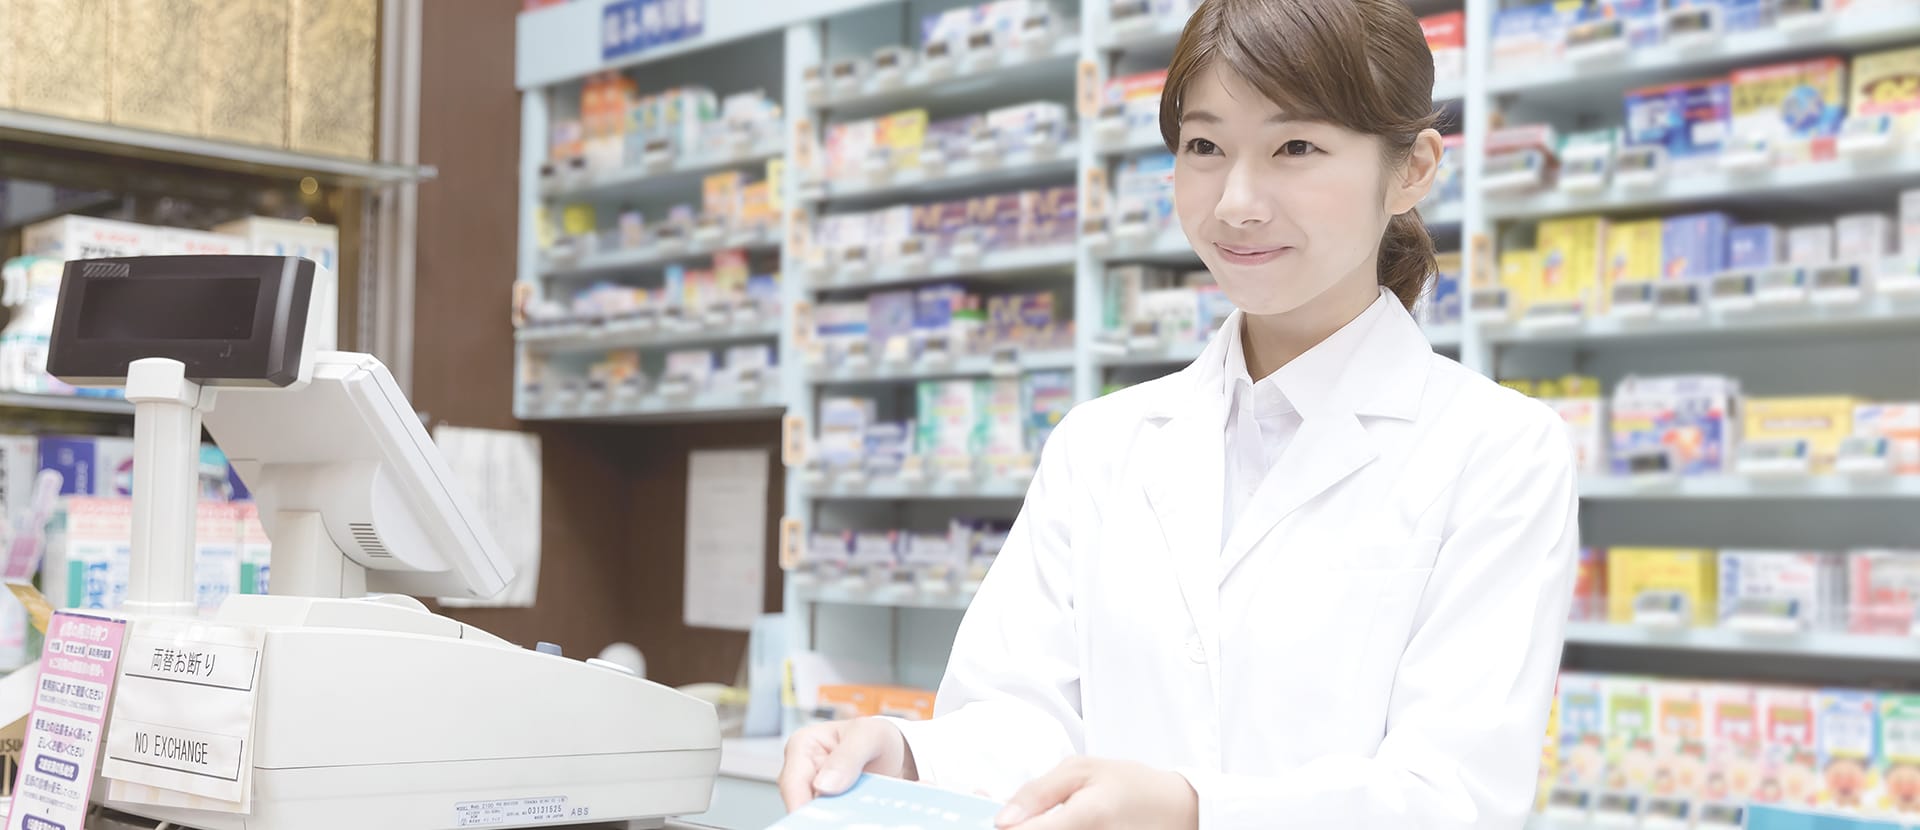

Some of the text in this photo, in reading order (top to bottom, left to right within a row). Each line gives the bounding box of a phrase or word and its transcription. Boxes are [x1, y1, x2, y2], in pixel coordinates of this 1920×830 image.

[151, 648, 216, 677] 両替お断り
[134, 732, 208, 765] NO EXCHANGE
[570, 807, 589, 816] ABS
